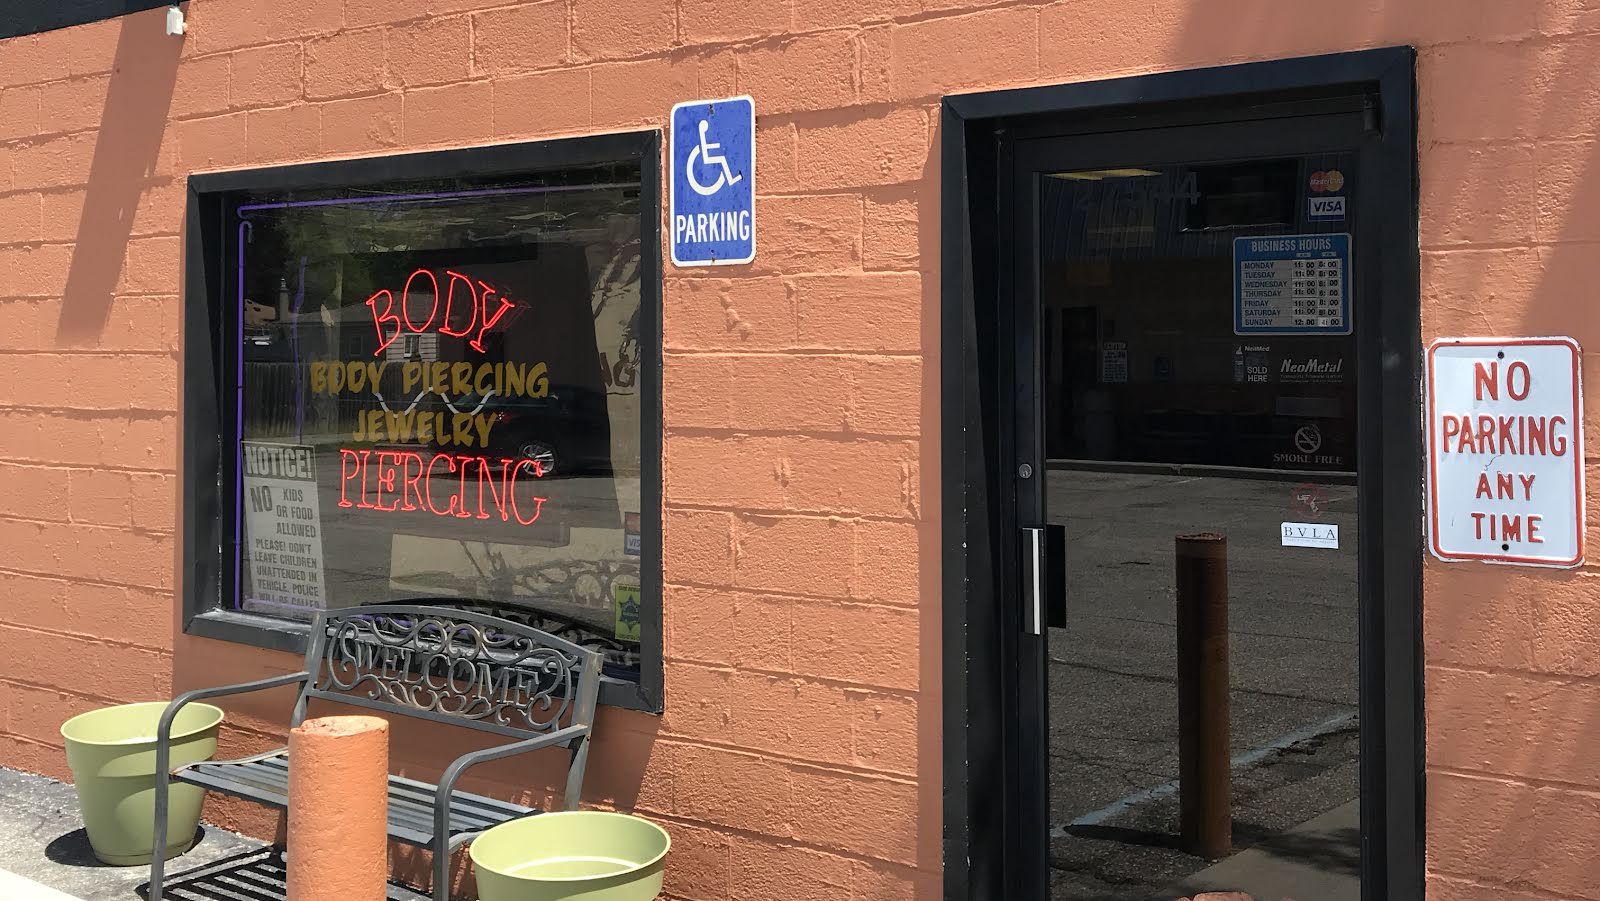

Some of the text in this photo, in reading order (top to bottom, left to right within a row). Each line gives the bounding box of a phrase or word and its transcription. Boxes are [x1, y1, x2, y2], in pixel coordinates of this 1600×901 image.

[1314, 201, 1342, 212] VISA
[676, 210, 750, 244] PARKING
[1251, 238, 1331, 252] BUSINESS HOURS
[365, 268, 515, 356] BODY
[1247, 366, 1268, 374] SOLD
[1280, 358, 1343, 373] NeoMetal
[310, 361, 549, 398] BODY PIERCING
[1247, 374, 1268, 383] HERE
[1474, 360, 1531, 401] NO
[352, 409, 498, 448] JEWELRY
[1442, 414, 1567, 457] PARKING
[245, 446, 312, 479] NOTICE!
[1273, 453, 1343, 465] SMOKE FREE
[337, 448, 547, 526] PIERCING
[1475, 472, 1536, 501] ANY
[250, 485, 303, 513] NO KIDS
[276, 504, 313, 520] OR FOOD
[276, 522, 316, 538] ALLOWED
[1471, 512, 1544, 544] TIME
[256, 538, 312, 555] PLEASE! DON'T
[629, 538, 641, 548] VIS
[255, 551, 317, 569] LEAVE CHILDREN
[256, 565, 317, 583] UNATTENDED IN
[292, 584, 319, 597] POLICE
[354, 638, 540, 708] WELCOME
